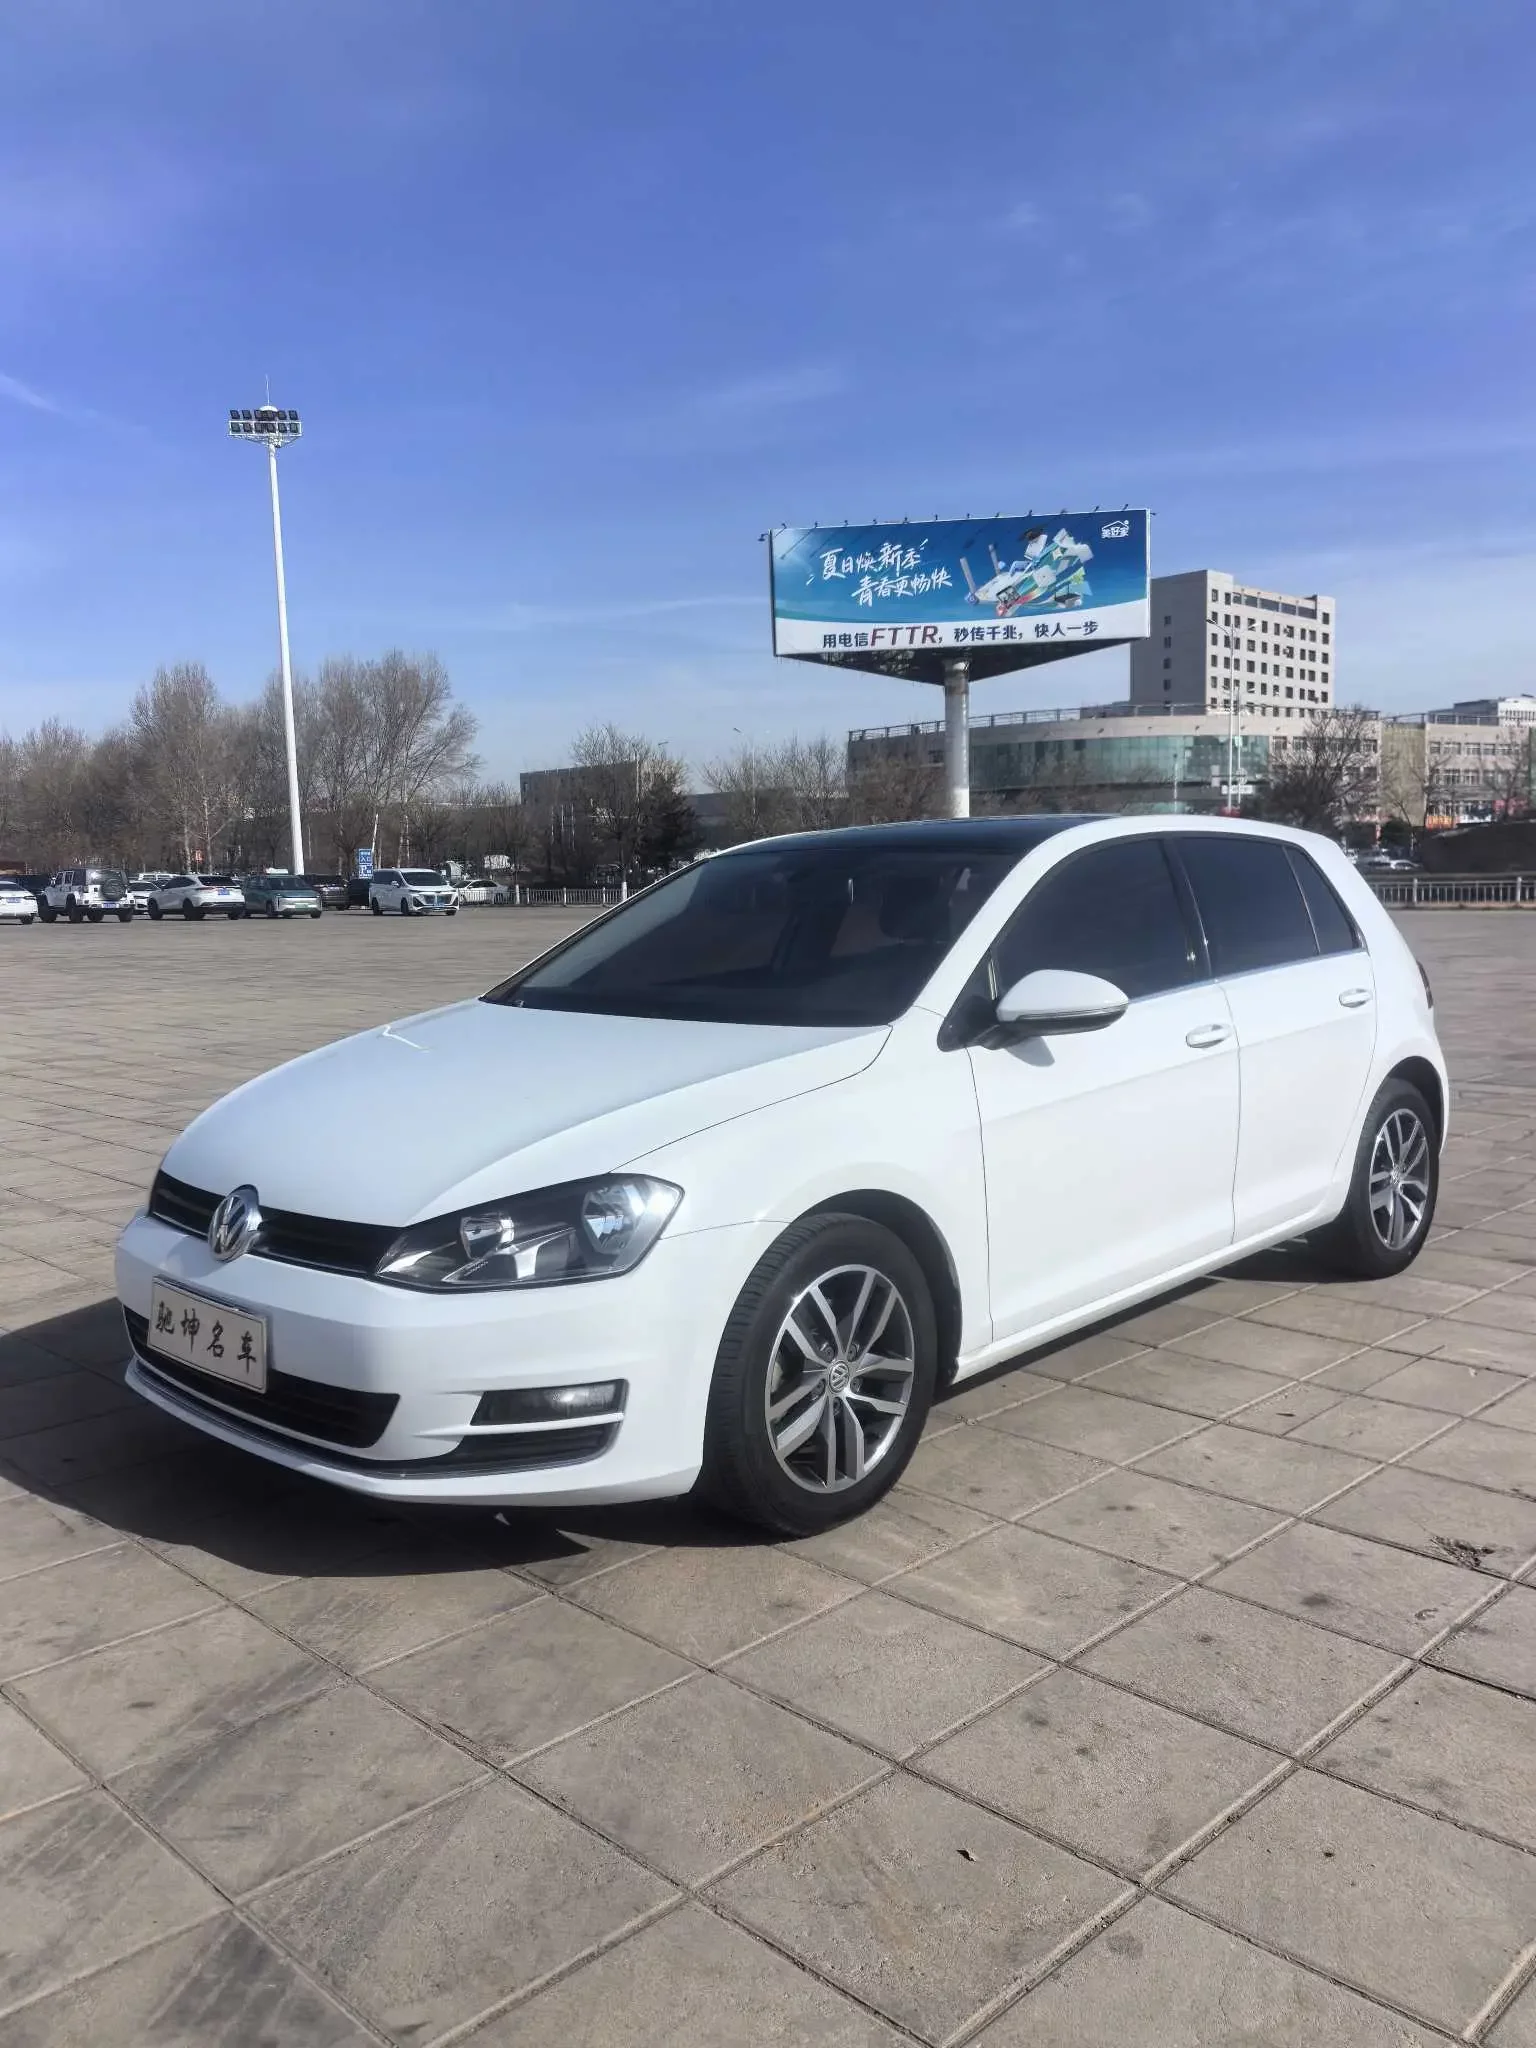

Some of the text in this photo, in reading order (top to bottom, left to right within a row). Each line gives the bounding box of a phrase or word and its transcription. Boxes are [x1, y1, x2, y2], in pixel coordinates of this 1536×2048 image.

[851, 567, 953, 606] 青春更畅快
